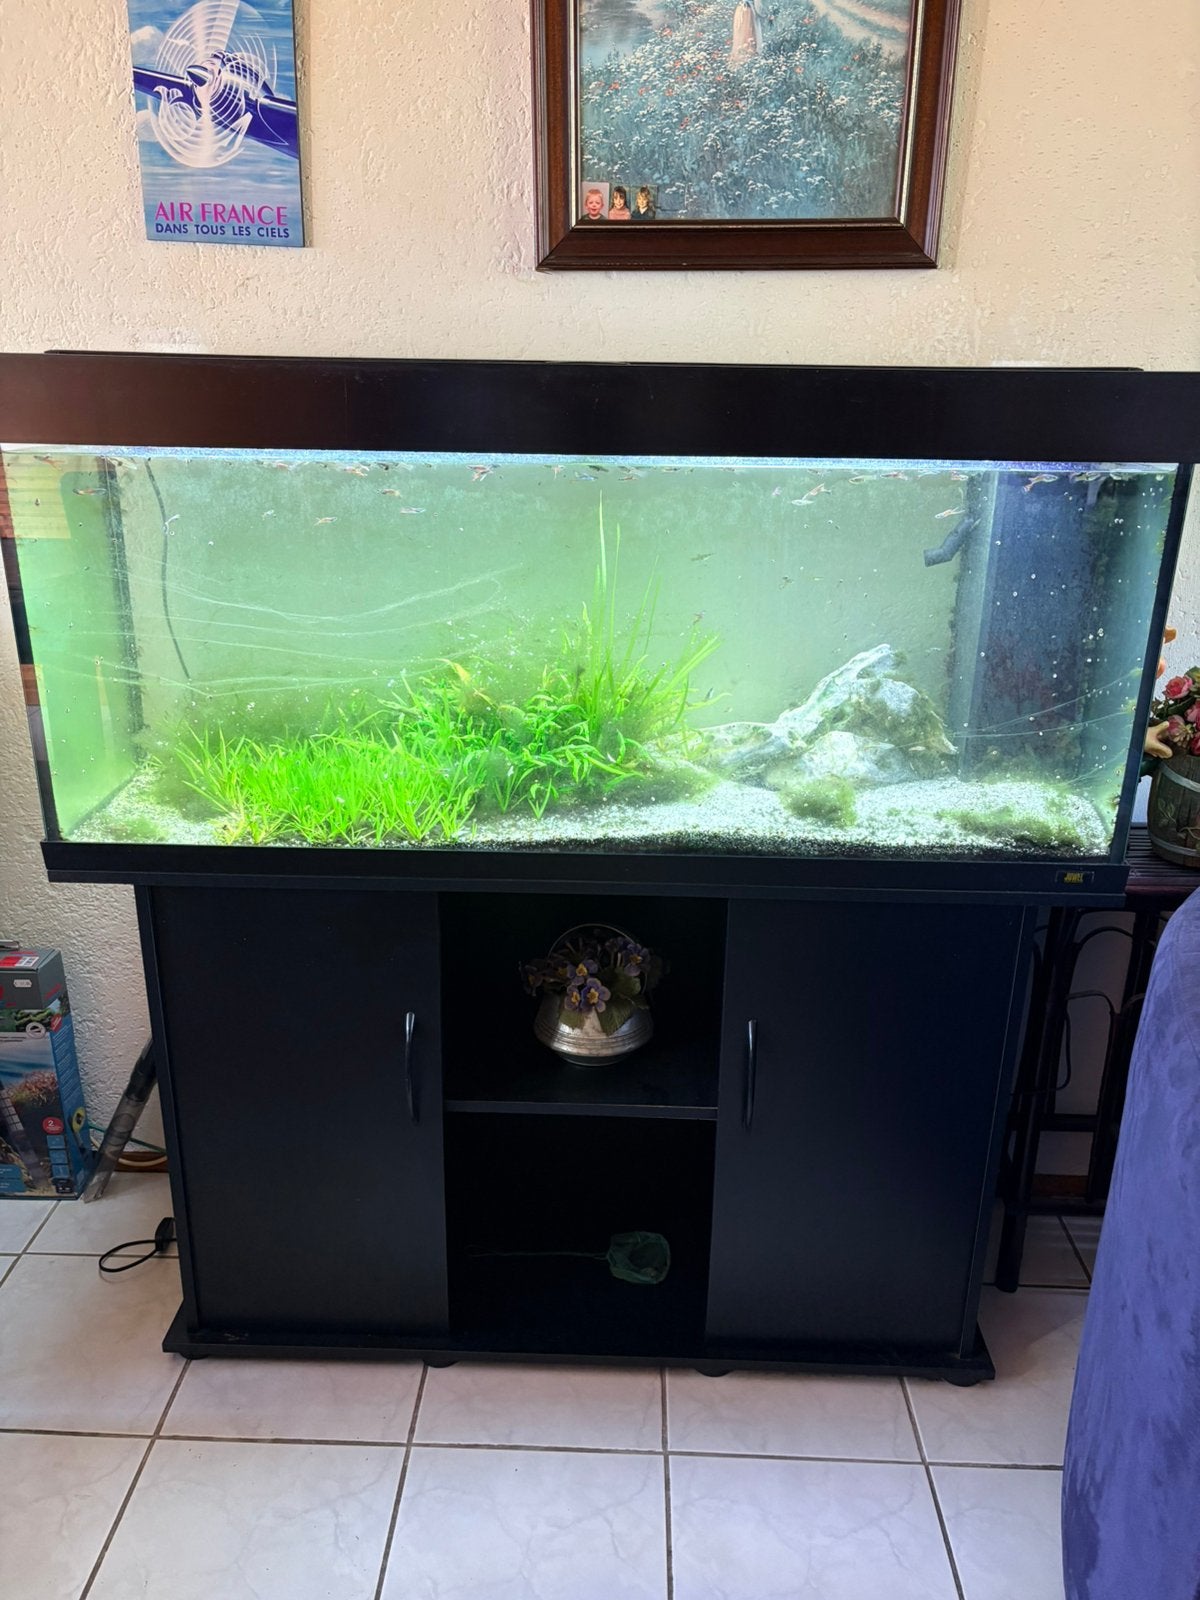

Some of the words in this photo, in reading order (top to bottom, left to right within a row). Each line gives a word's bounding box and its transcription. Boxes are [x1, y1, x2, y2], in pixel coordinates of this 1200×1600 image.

[155, 201, 193, 222] AIR
[200, 203, 288, 226] FRANCE
[155, 223, 188, 234] DANS
[195, 224, 225, 235] TOUS
[232, 226, 251, 236] LES
[257, 227, 290, 238] CIELS
